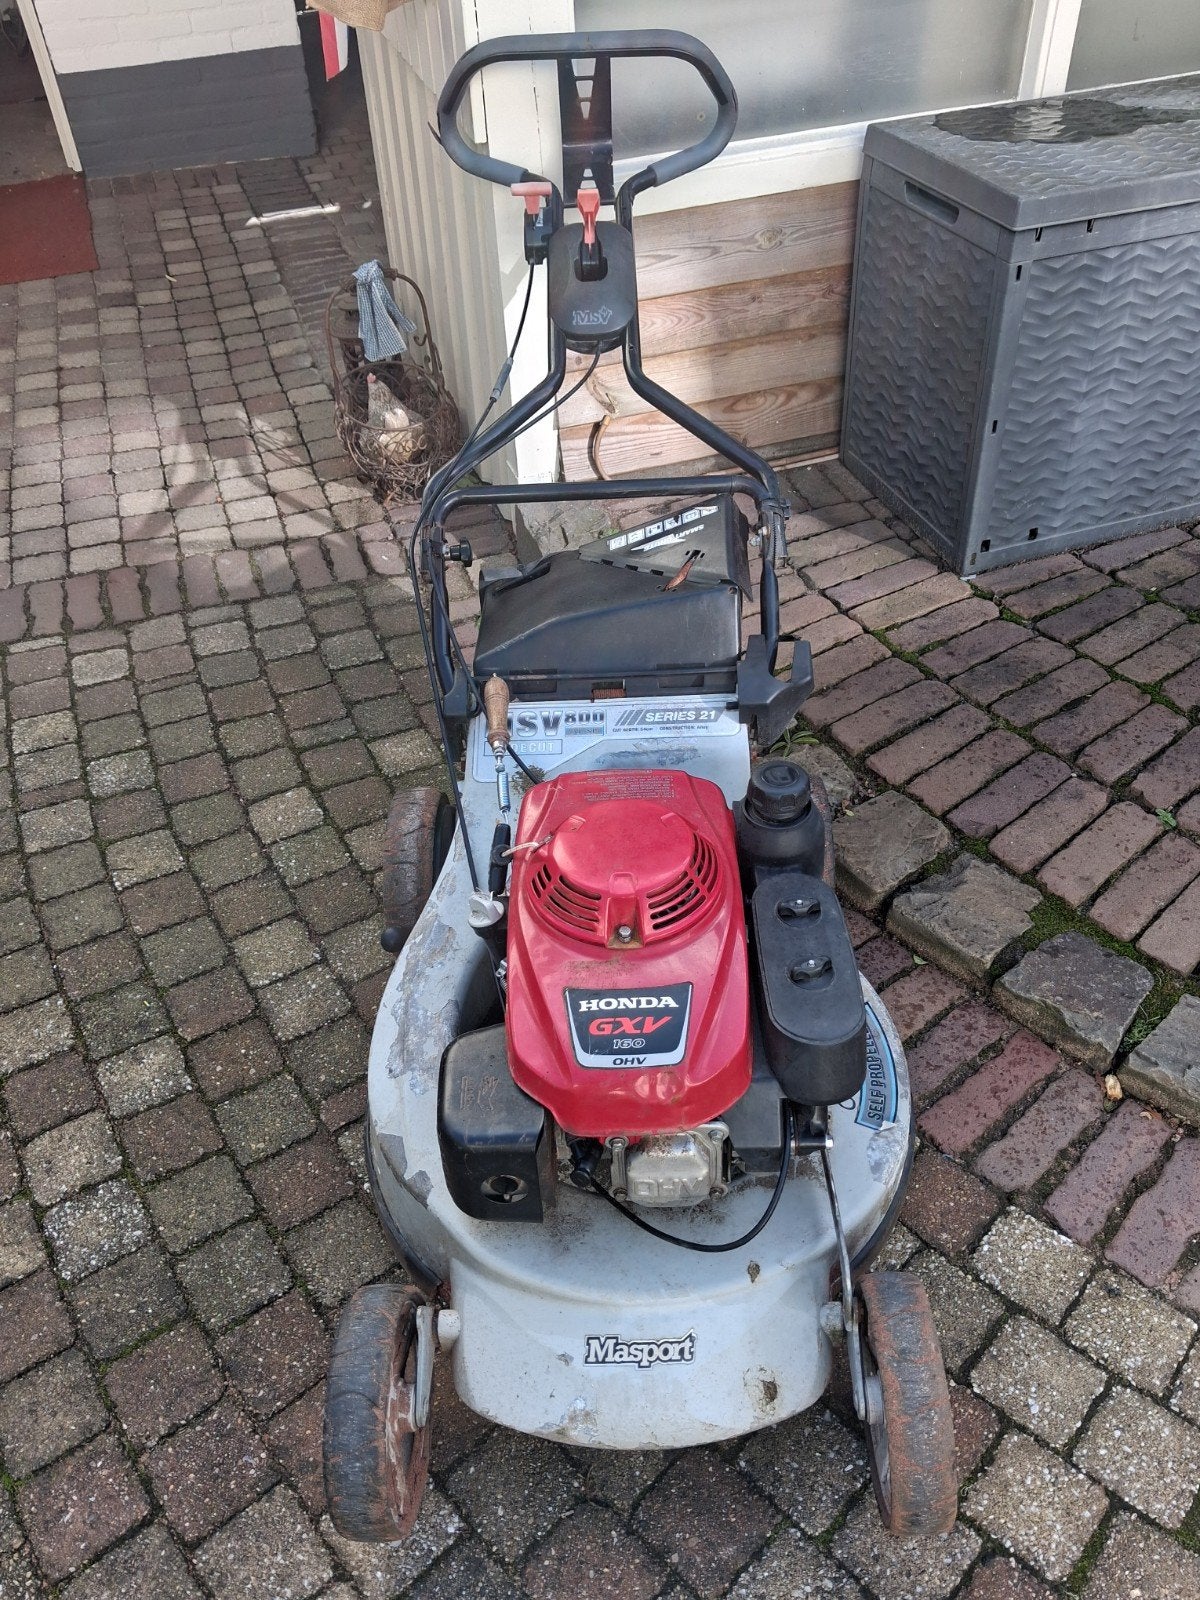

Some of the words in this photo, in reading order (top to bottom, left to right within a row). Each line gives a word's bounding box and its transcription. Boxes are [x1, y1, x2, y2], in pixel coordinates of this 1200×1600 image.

[508, 710, 563, 737] SV
[564, 710, 605, 725] 800
[645, 710, 696, 722] SERIES
[699, 710, 716, 721] 21
[579, 996, 679, 1012] HONDA
[588, 1016, 672, 1036] GXV
[613, 1038, 646, 1049] 160
[612, 1057, 647, 1066] OHV
[867, 1089, 886, 1120] SELF
[633, 1177, 704, 1198] OHV
[585, 1333, 695, 1368] Masport
